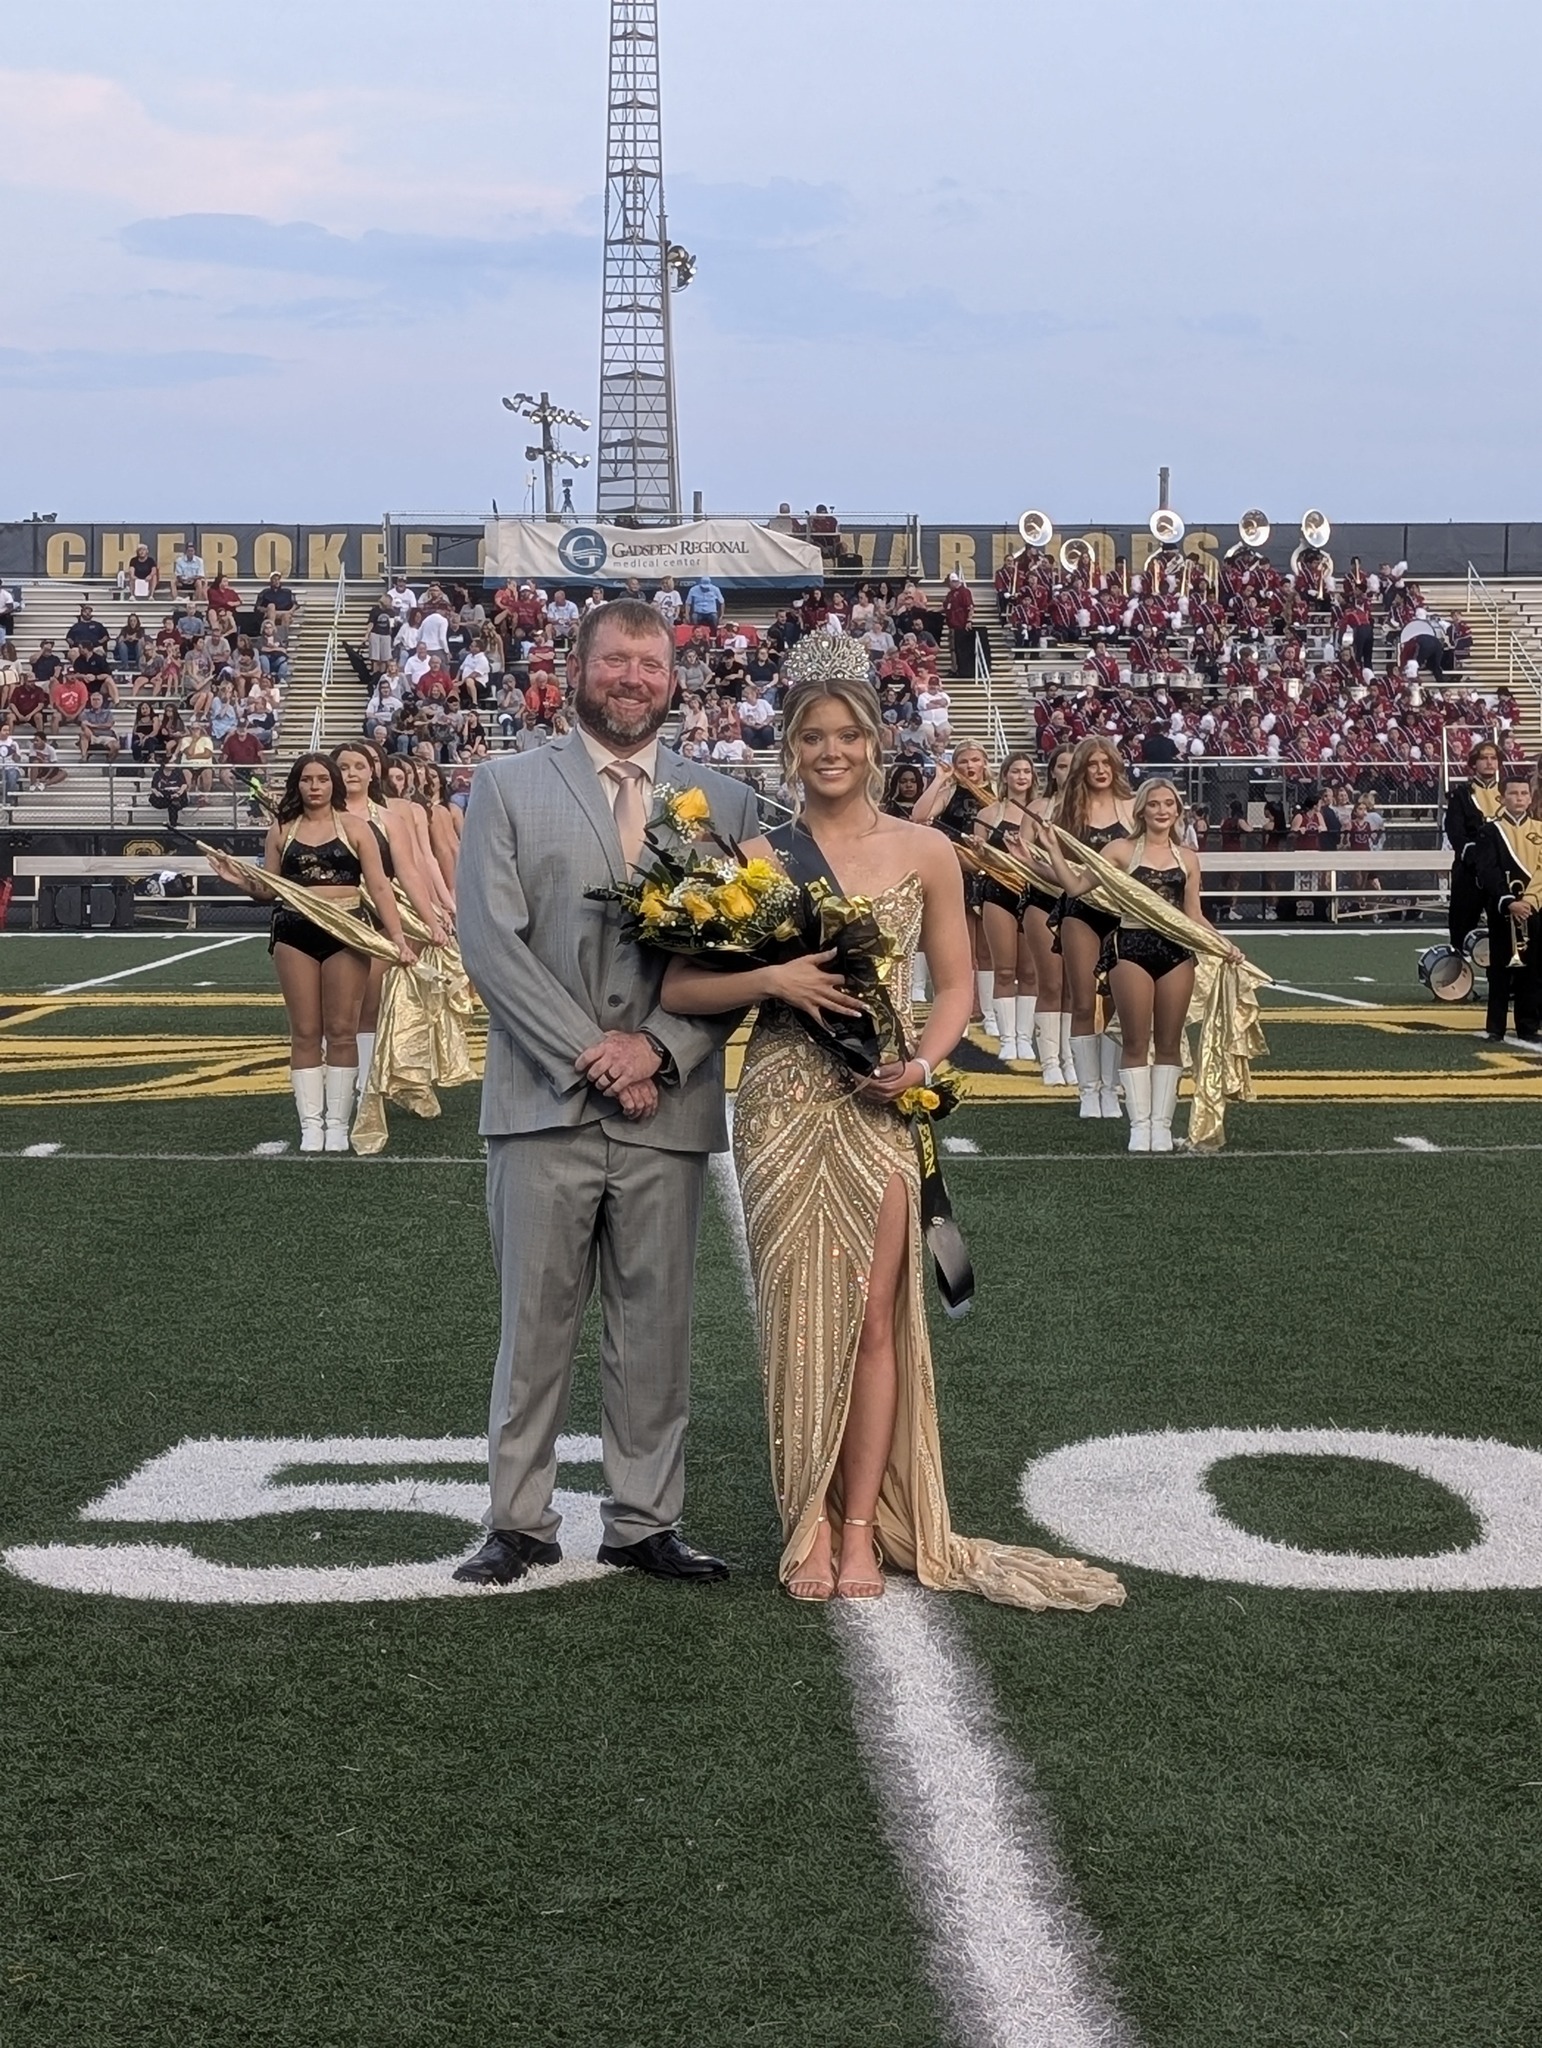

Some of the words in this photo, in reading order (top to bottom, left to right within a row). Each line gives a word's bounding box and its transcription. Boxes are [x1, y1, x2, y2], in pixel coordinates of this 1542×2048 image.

[46, 532, 434, 579] CHEROKEE
[611, 542, 678, 558] GADSDEN
[680, 540, 750, 555] REGIONAL
[613, 558, 659, 568] medical
[663, 558, 701, 567] center
